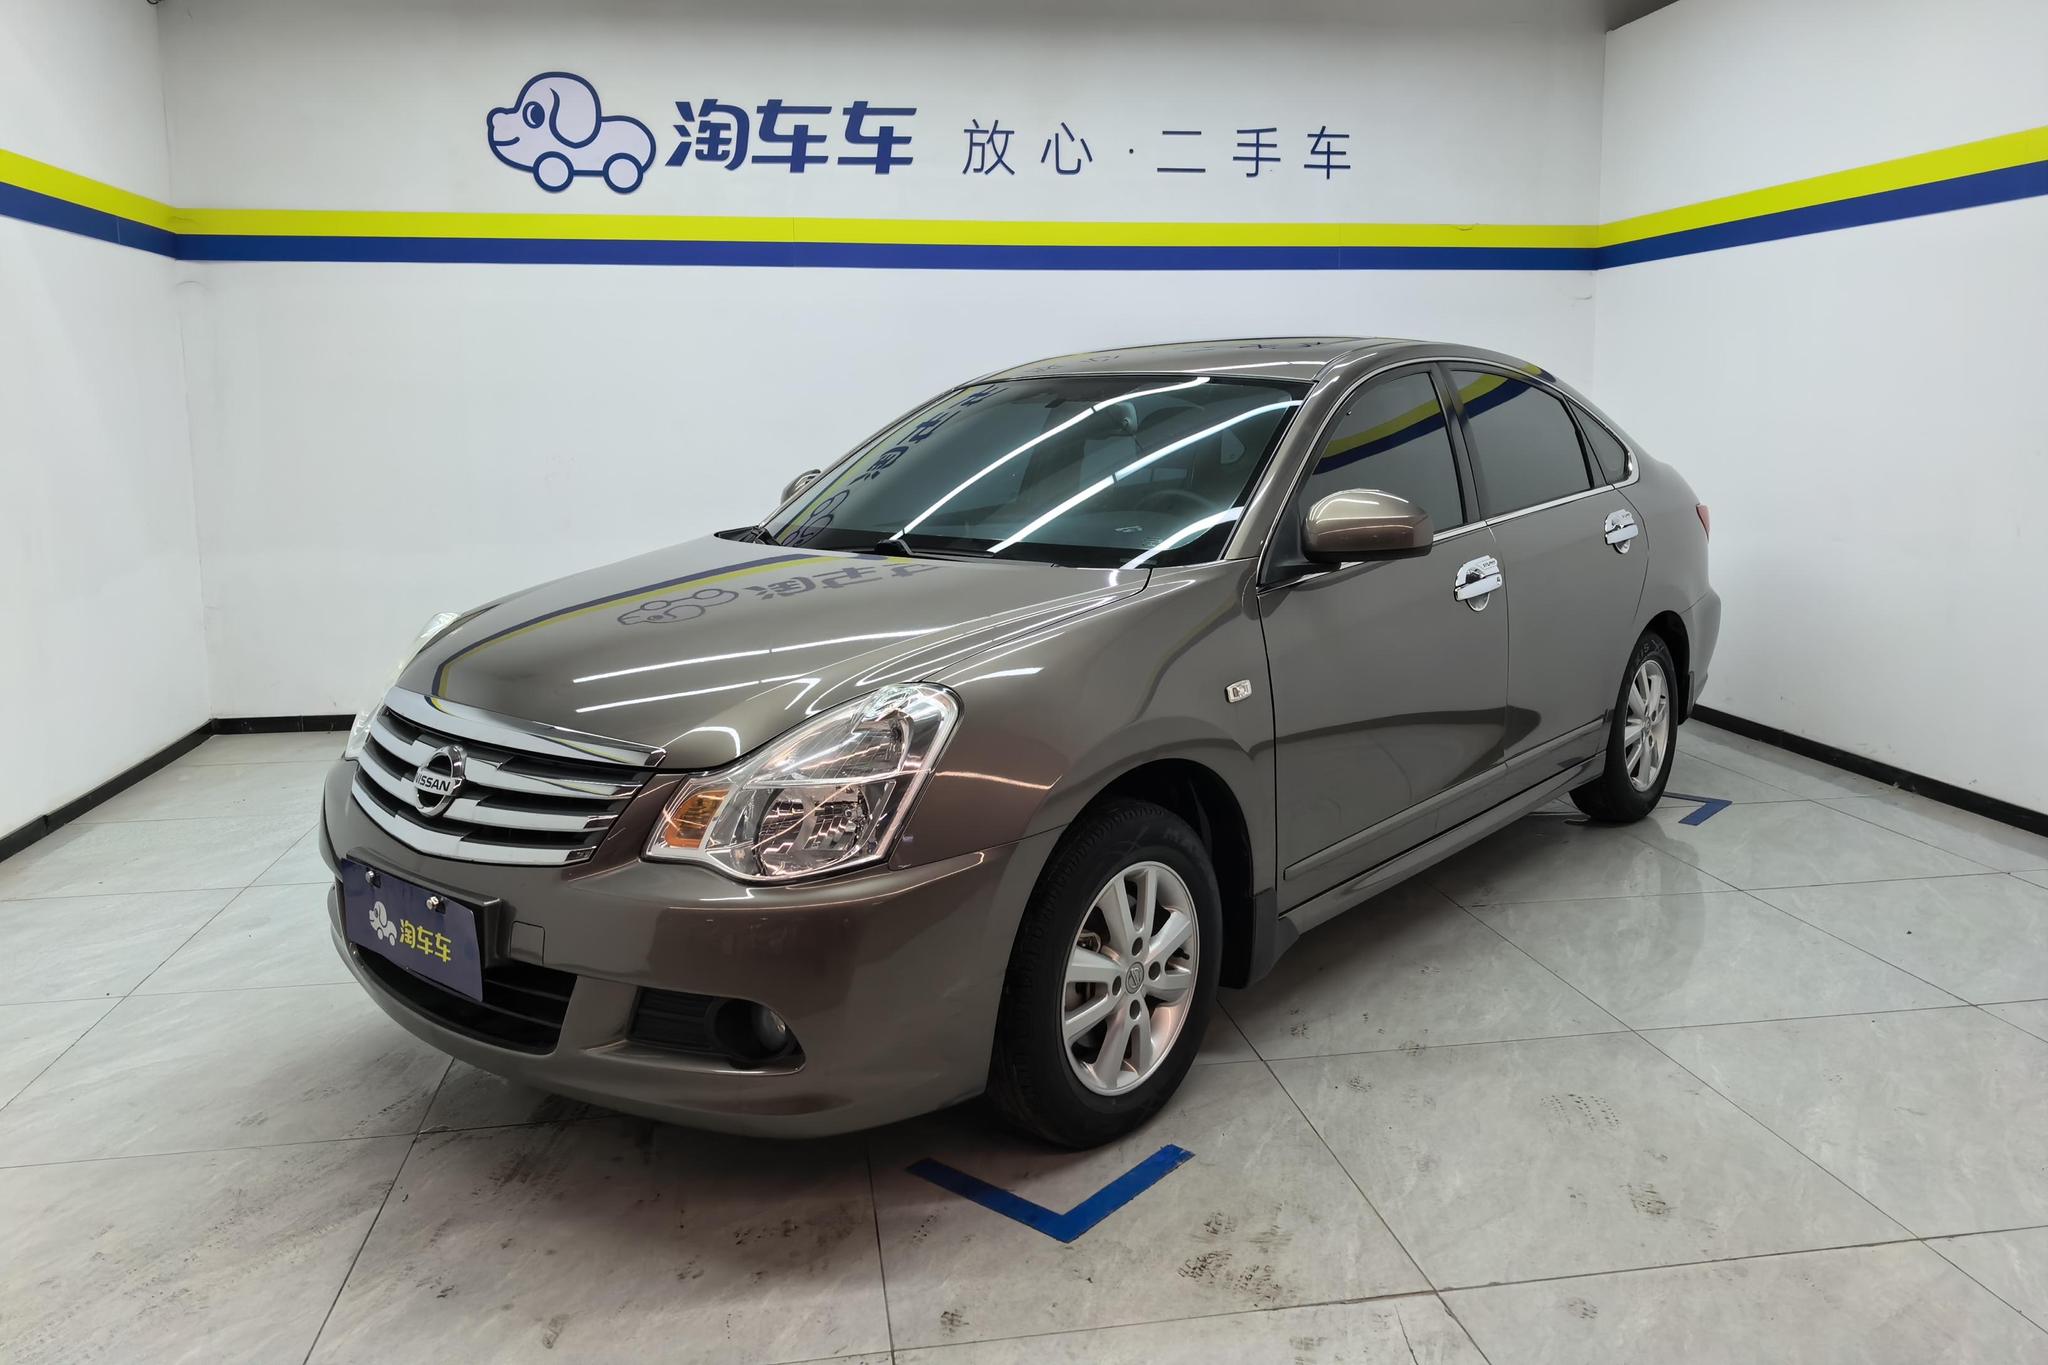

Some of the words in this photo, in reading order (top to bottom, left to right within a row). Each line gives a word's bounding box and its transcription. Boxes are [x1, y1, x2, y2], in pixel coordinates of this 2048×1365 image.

[664, 98, 918, 175] 淘车车
[415, 773, 451, 792] NISSAN
[399, 918, 452, 963] 淘车车
